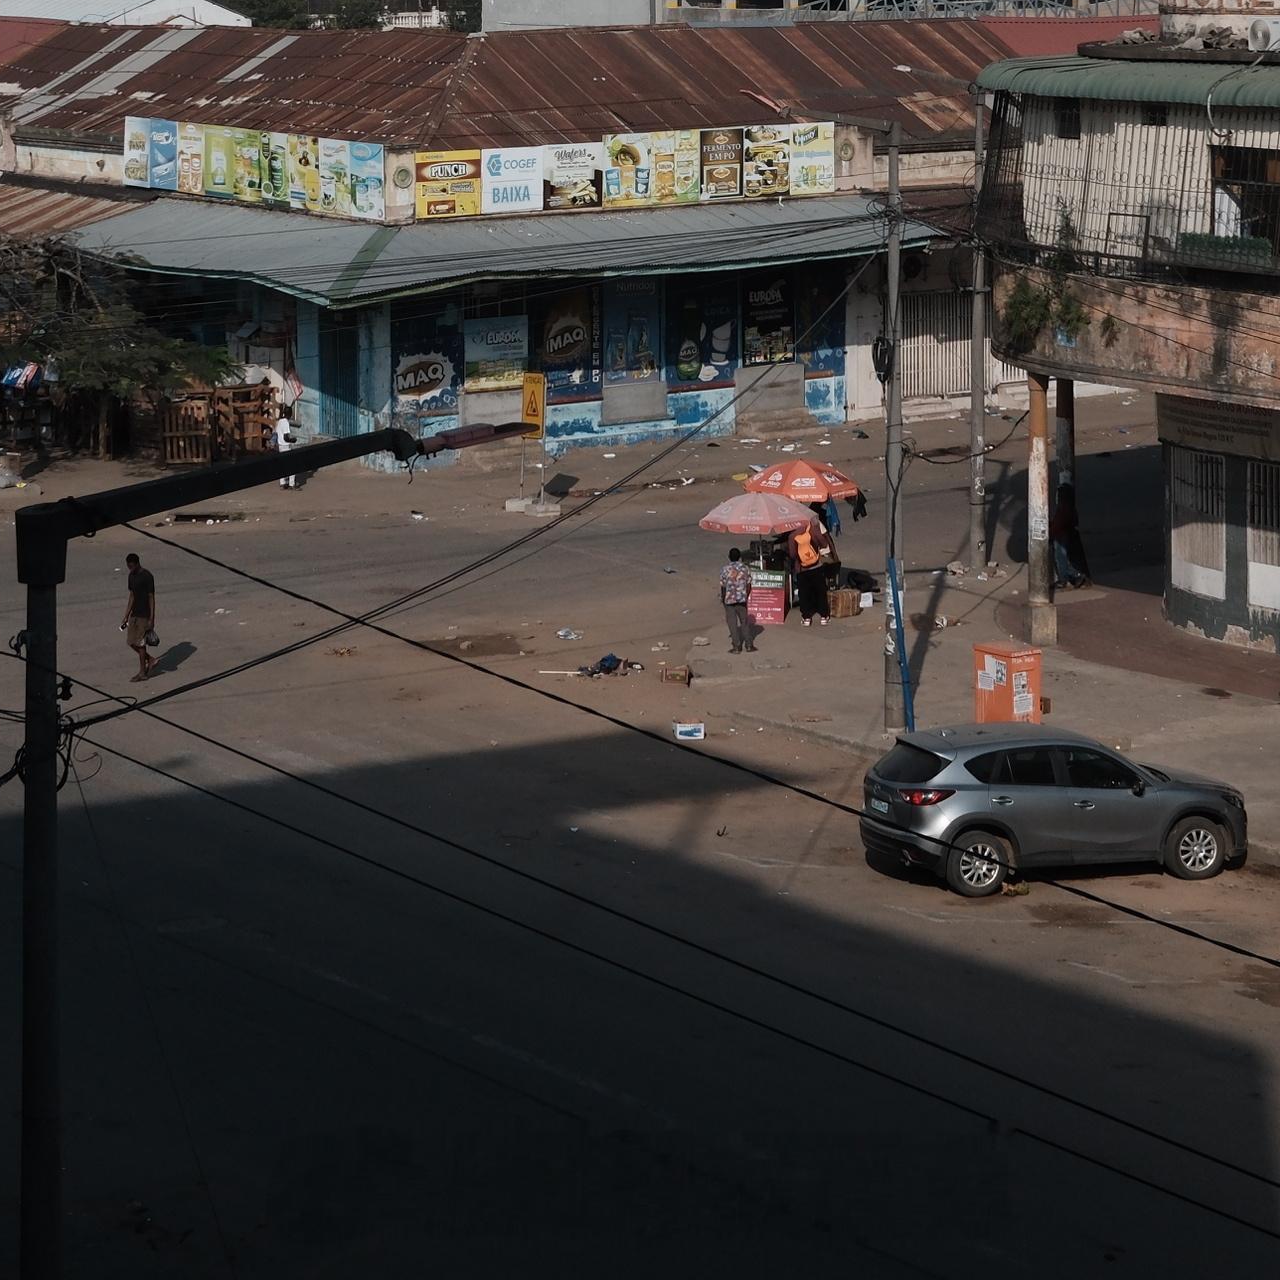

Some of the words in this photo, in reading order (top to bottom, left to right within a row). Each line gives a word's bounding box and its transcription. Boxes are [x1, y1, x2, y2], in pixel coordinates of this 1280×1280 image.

[554, 148, 588, 163] Wafers
[703, 144, 741, 153] FERMENTO
[431, 163, 467, 178] PUNCH
[503, 158, 537, 170] COGEF
[492, 185, 531, 204] BAIXA
[546, 326, 587, 354] MAQ
[396, 362, 445, 391] MAQ
